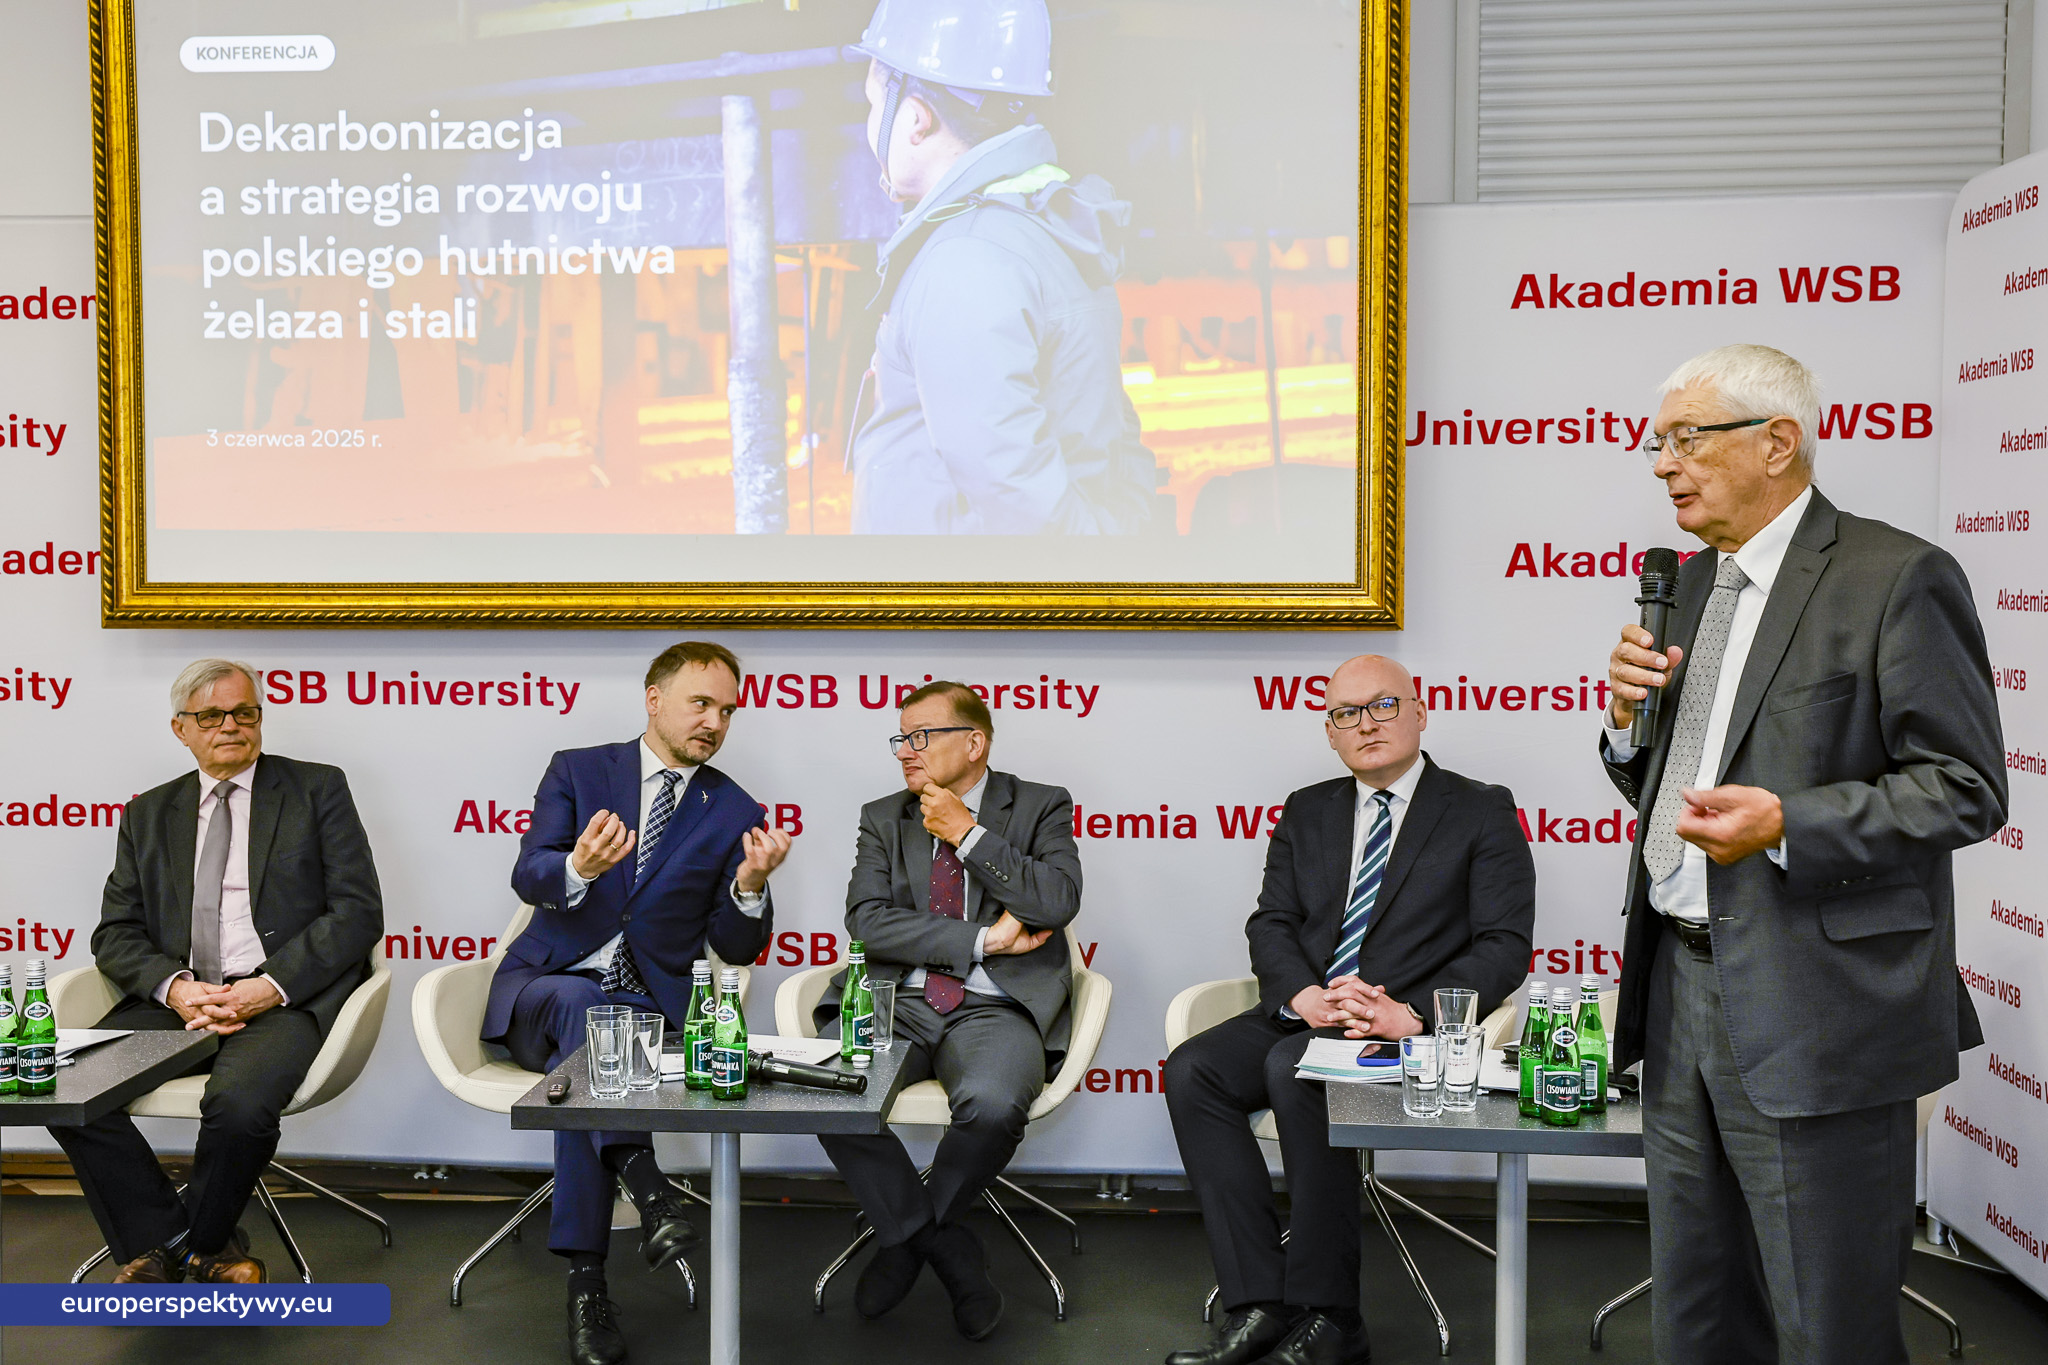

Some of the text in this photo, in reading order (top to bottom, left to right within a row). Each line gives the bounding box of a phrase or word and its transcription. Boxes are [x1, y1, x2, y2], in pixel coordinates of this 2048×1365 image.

[196, 44, 318, 61] KONFERENCJA
[200, 108, 563, 161] Dekarbonizacja
[200, 170, 643, 226] a strategia rozwoju
[1962, 185, 2039, 233] Akademia WSB
[203, 235, 675, 289] polskiego hutnictwa
[1511, 265, 1901, 309] Akademia WSB
[203, 297, 477, 339] żelaza i stali
[1959, 348, 2034, 384] Akademia WSB
[206, 429, 383, 448] 3 czerwca 2025 r.
[1817, 402, 1933, 440] WSB
[1955, 510, 2029, 533] Akademia WSB
[254, 670, 581, 715] SB University
[736, 674, 839, 709] WSB
[1254, 676, 1612, 712] WS niversit
[2003, 668, 2027, 691] WSB
[2005, 748, 2046, 776] ademia
[2001, 825, 2024, 850] WSB
[1991, 899, 2044, 938] Akademia
[1957, 965, 2021, 1008] ademia WSB
[1989, 1053, 2042, 1100] Akademia
[1944, 1105, 2019, 1169] Akademia WSB
[1986, 1202, 2039, 1259] Akademia
